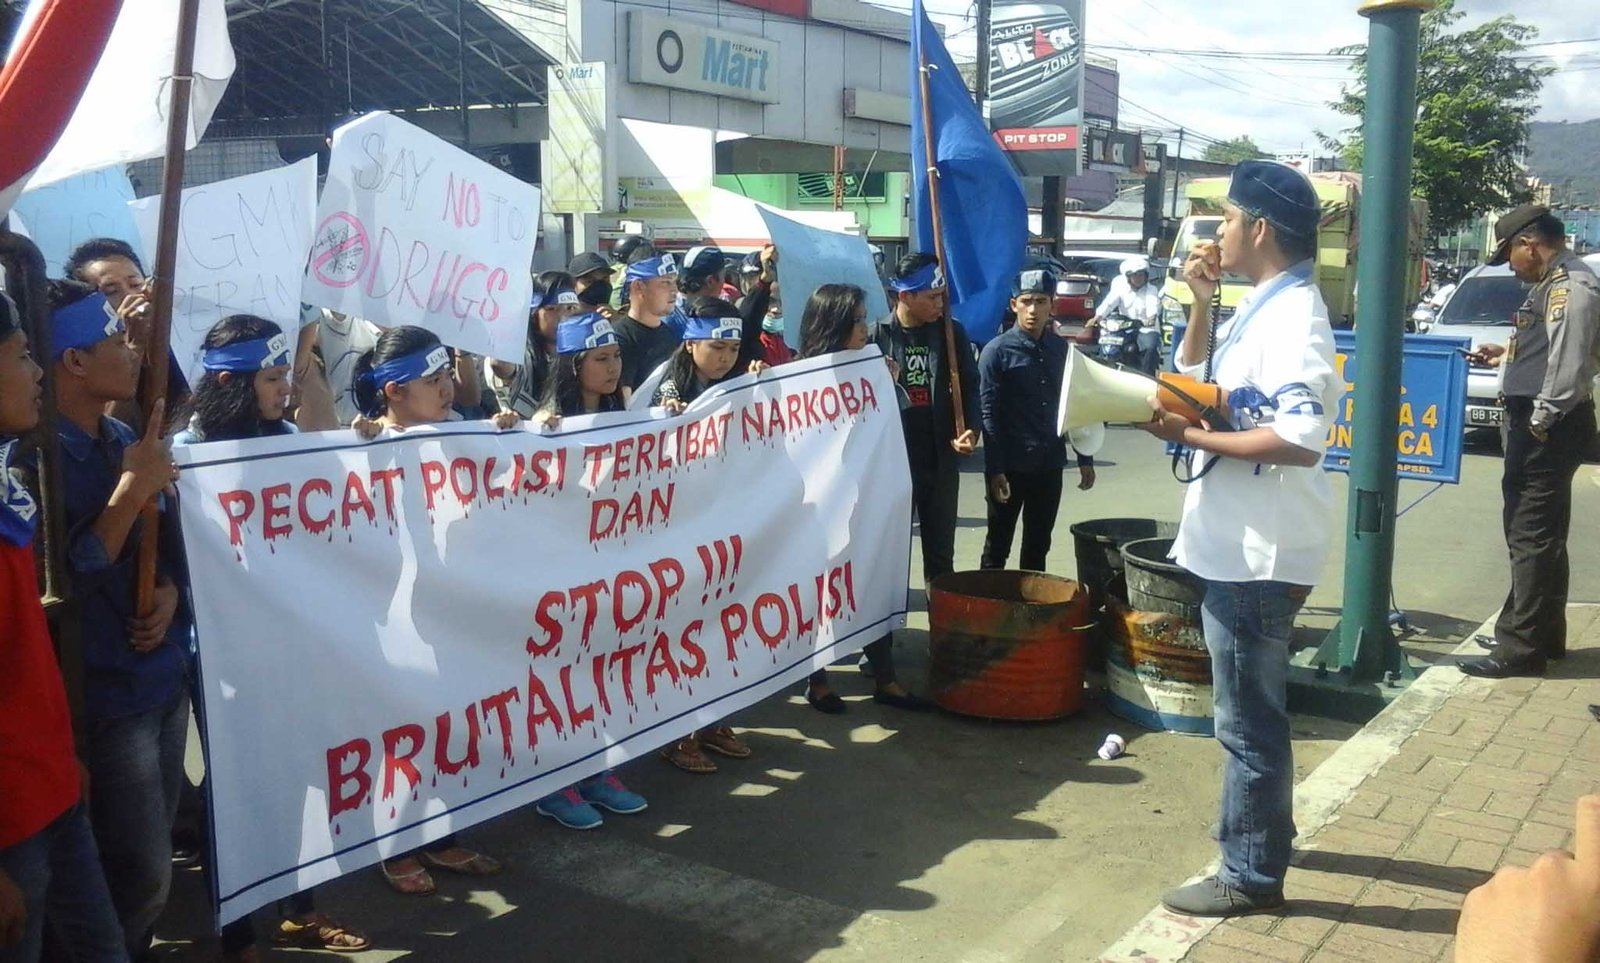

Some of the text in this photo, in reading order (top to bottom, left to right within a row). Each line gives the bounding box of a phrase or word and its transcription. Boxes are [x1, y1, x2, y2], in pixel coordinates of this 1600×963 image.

[569, 67, 593, 79] Mart
[701, 36, 770, 92] Mart
[1041, 51, 1077, 81] ZONE
[352, 133, 435, 211] SAY
[1004, 132, 1067, 144] PIT STOP
[443, 171, 525, 244] NO TO
[366, 226, 510, 332] DRUGS
[1421, 404, 1438, 429] 4
[218, 377, 880, 559] PECAT POLISI TERLIBAT NARKOBA
[588, 482, 677, 550] DAN
[527, 534, 745, 660] STOP !!!
[326, 560, 857, 824] BRUTALITAS POLISI
